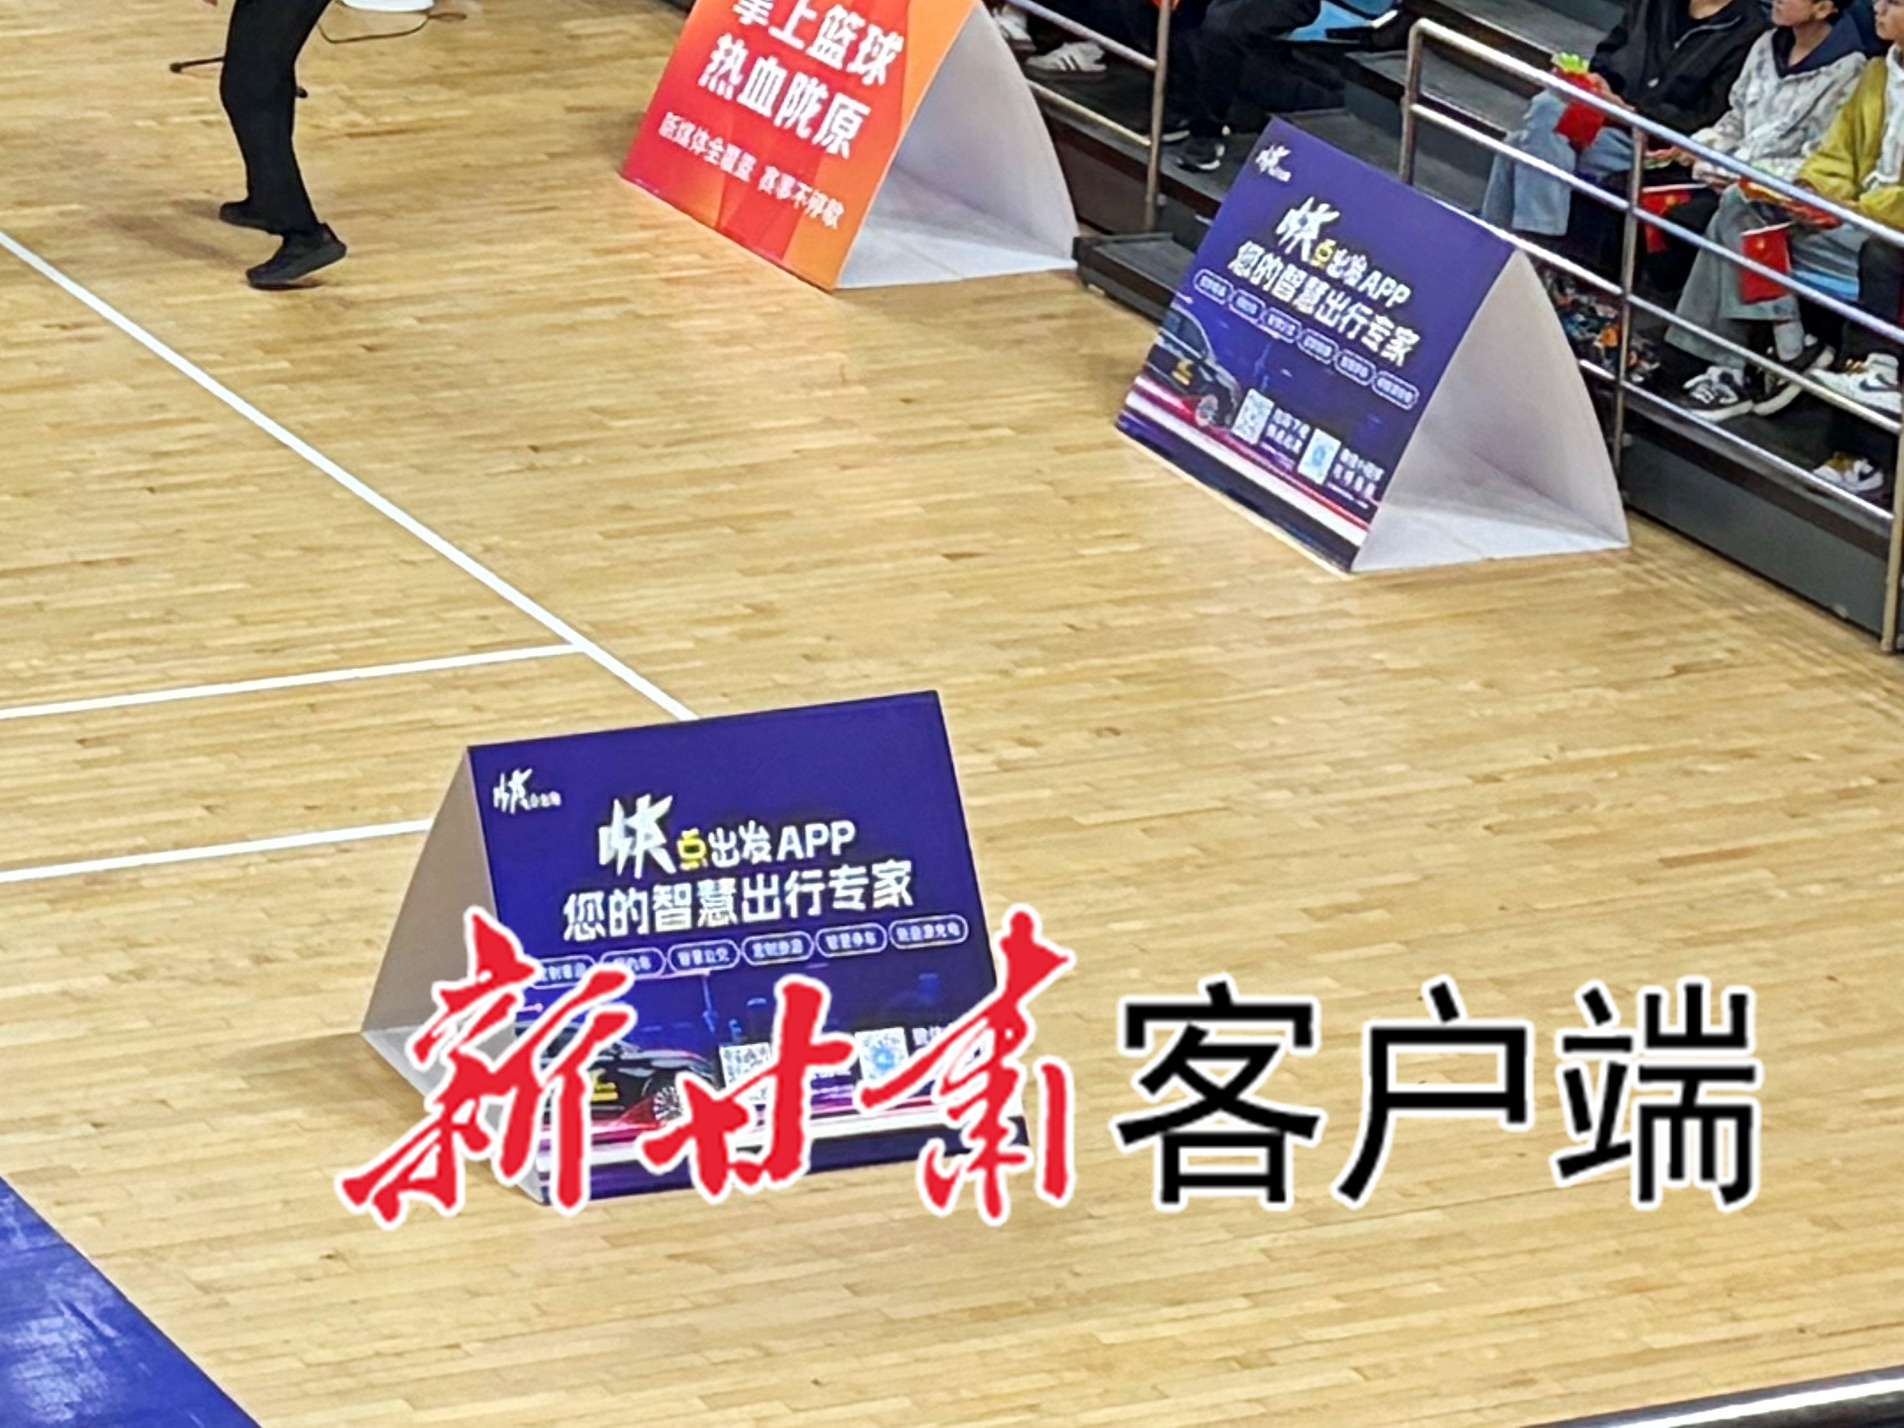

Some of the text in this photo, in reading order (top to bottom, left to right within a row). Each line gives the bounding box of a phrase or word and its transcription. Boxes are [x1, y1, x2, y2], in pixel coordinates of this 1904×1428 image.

[697, 32, 872, 160] 热血陇原
[597, 792, 857, 879] 快点出发APP
[562, 858, 914, 943] 您的智慧出行专家
